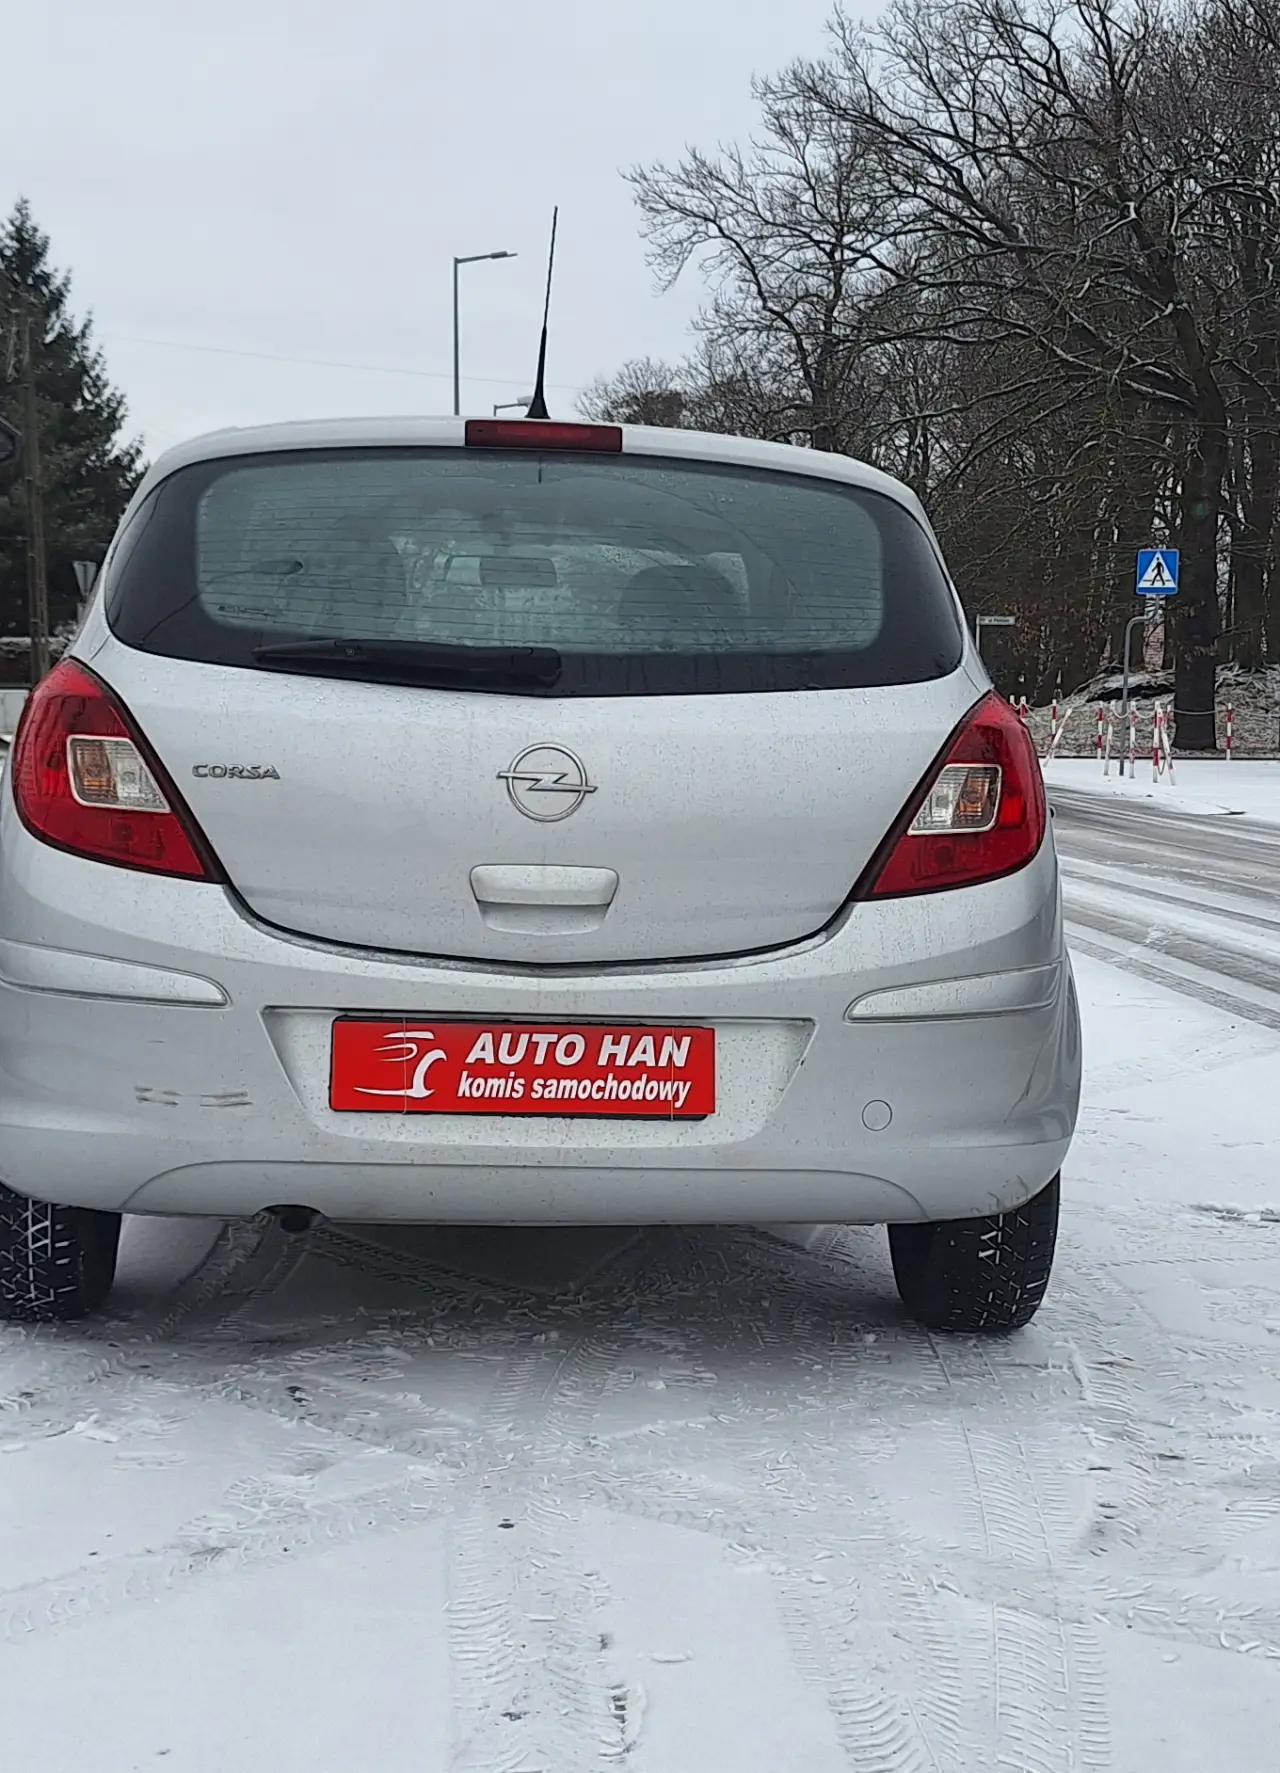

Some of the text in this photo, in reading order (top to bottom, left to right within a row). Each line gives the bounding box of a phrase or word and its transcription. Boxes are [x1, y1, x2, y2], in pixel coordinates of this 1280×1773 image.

[191, 763, 281, 780] CORSA
[465, 1032, 692, 1068] AUTO HAN
[456, 1070, 692, 1109] komis samochodowy
